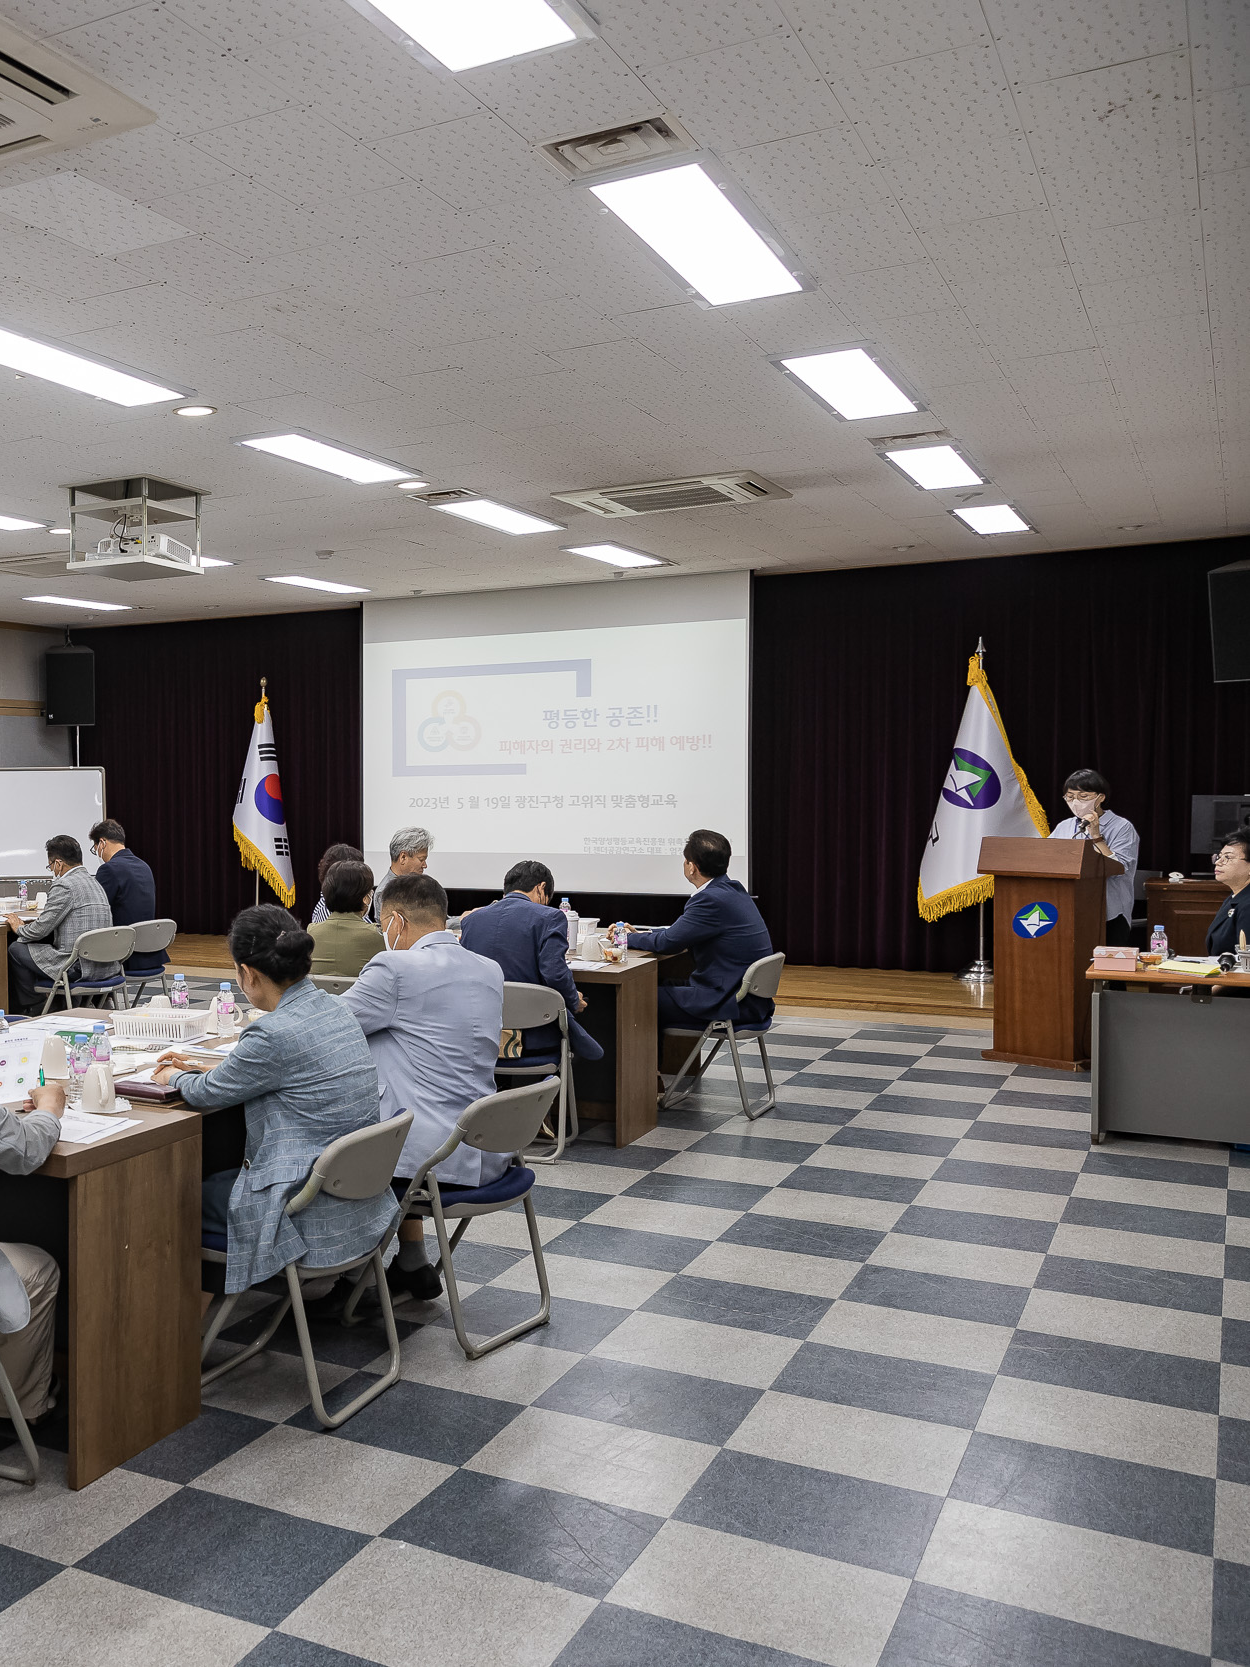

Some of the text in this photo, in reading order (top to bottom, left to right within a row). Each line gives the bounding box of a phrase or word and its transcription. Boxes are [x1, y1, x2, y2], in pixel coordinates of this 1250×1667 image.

[543, 705, 657, 729] 평등한 공존!!
[499, 734, 712, 754] 피해자의 권리와 2차 피해 예방!!
[409, 794, 678, 809] 2023년 5 월 19일 광진구청 고위직 맞춤형교육
